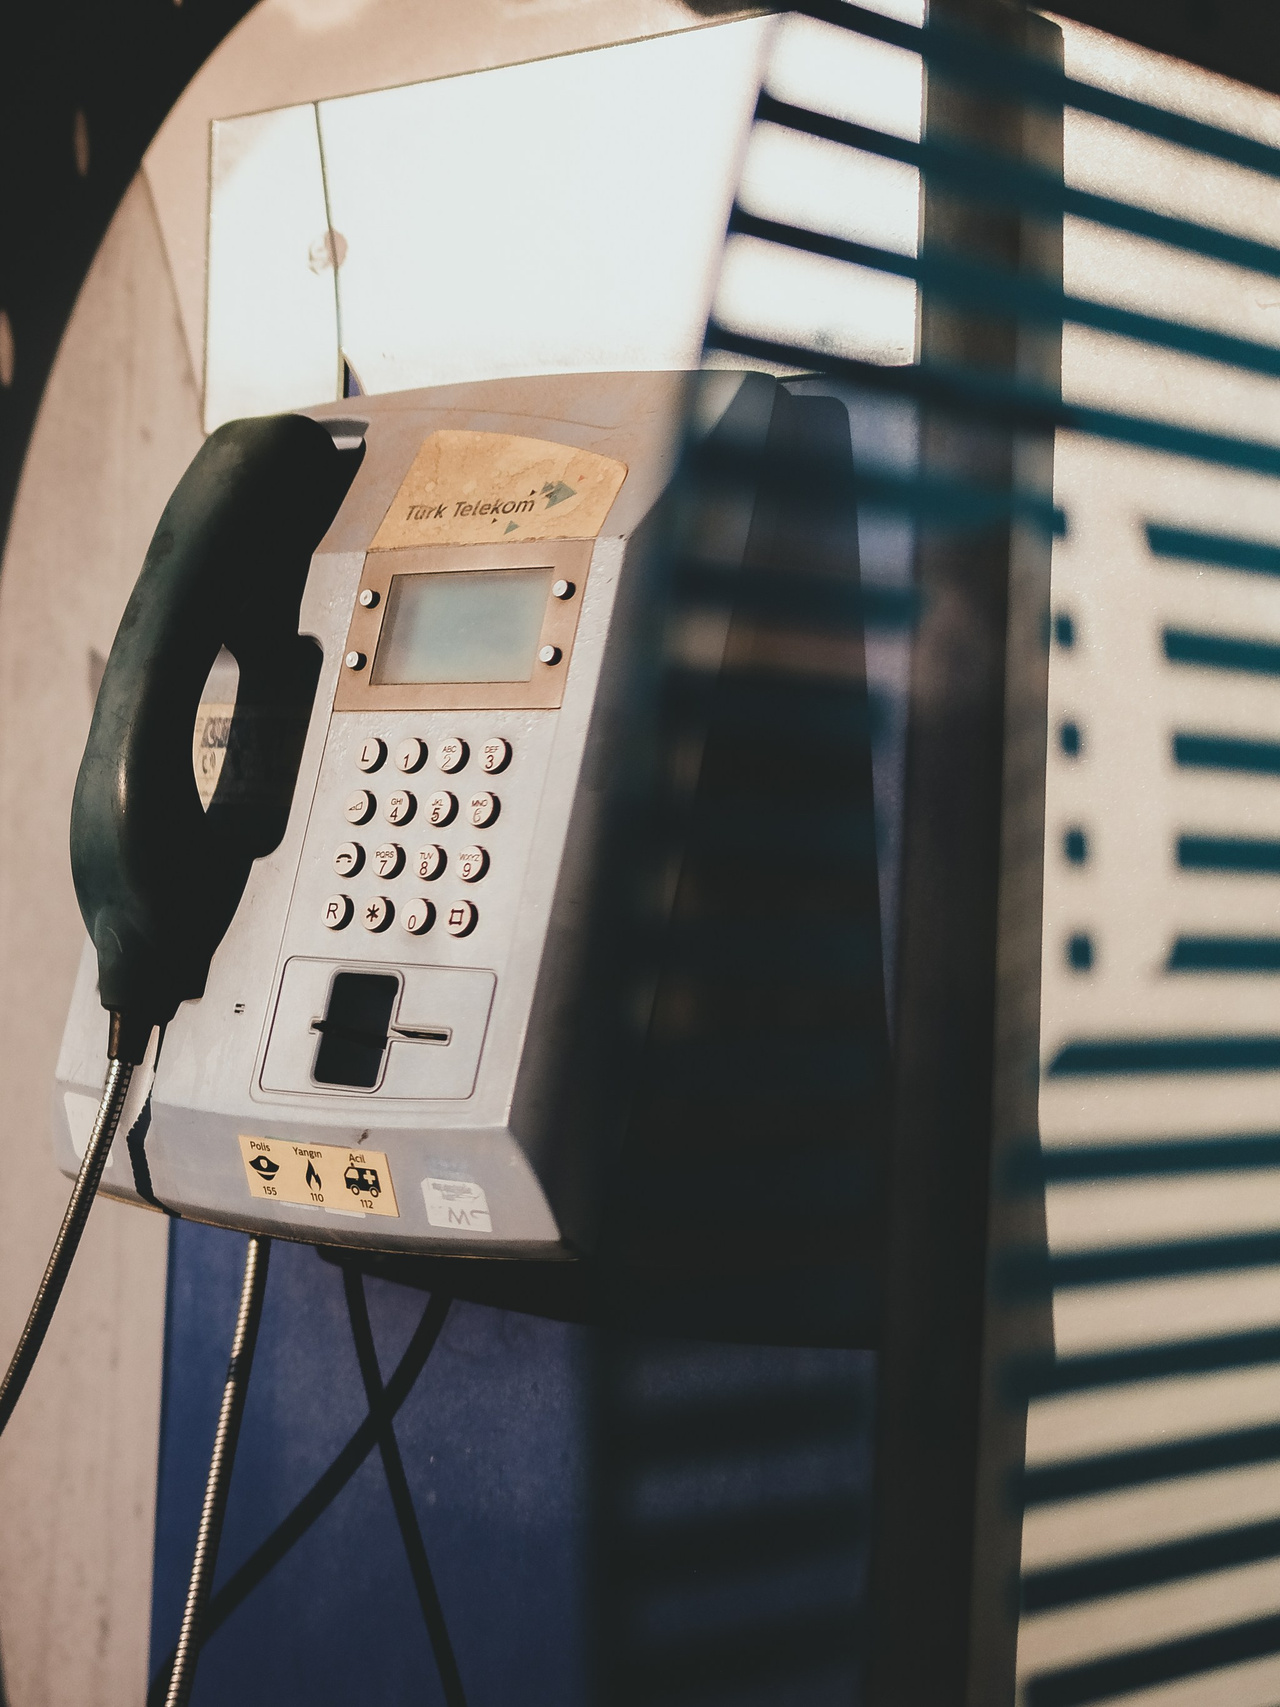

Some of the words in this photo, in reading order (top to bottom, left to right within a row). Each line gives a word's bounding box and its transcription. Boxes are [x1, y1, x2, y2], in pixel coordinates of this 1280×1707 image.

[453, 499, 535, 518] Telekom
[361, 745, 370, 762] L
[442, 745, 457, 753] ABC
[484, 745, 499, 754] DEF
[403, 753, 410, 768] 1
[441, 753, 452, 769] 2
[485, 754, 494, 769] 3
[389, 806, 398, 821] 4
[430, 807, 441, 822] 5
[472, 807, 482, 823] 6
[375, 850, 395, 859] PQRS
[420, 852, 434, 860] TUV
[379, 859, 388, 875] 7
[419, 861, 428, 876] 8
[462, 862, 472, 878] 9
[326, 902, 339, 919] R
[407, 914, 417, 930] 0
[249, 1140, 271, 1152] Polis
[348, 1153, 366, 1164] Acil
[262, 1185, 278, 1196] 155
[310, 1192, 324, 1203] 110
[359, 1199, 374, 1210] 112
